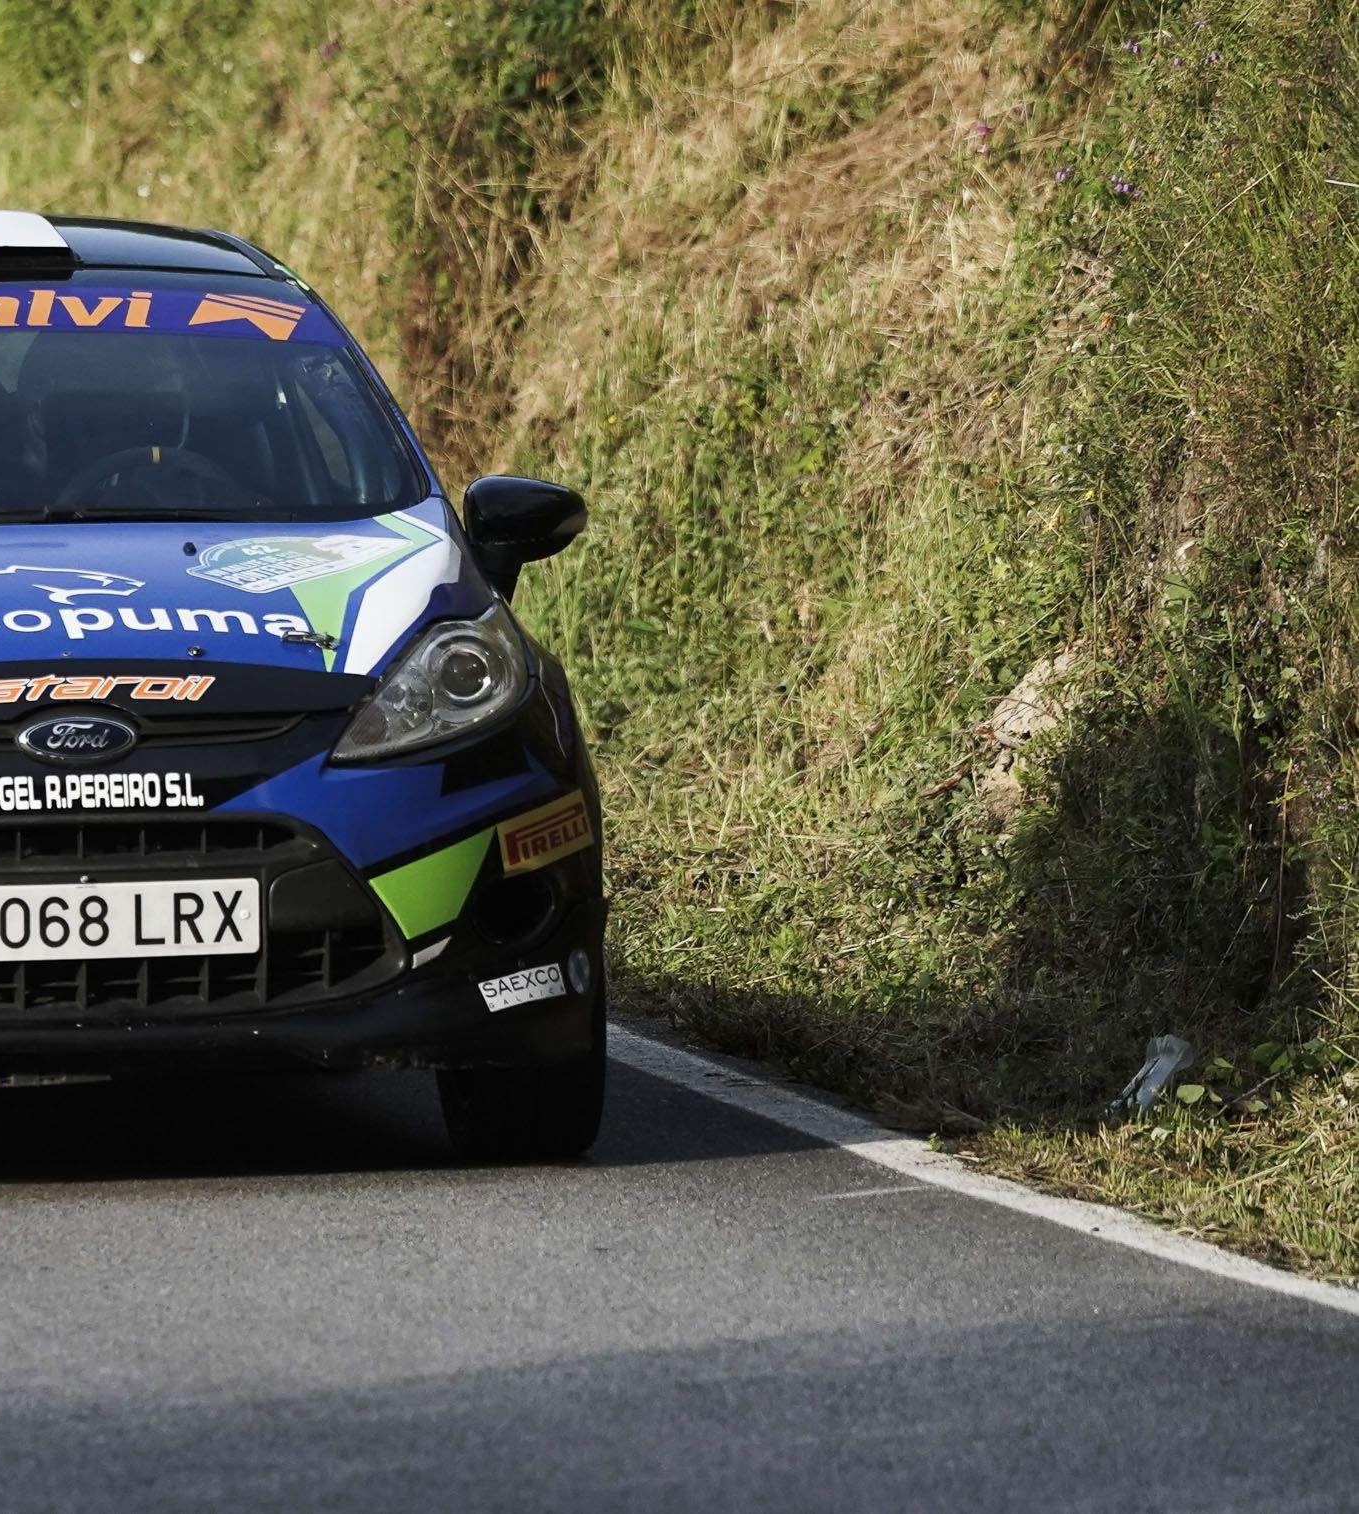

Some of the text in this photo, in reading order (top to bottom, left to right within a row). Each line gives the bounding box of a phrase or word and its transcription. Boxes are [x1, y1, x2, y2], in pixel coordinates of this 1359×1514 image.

[47, 722, 109, 749] Ford
[45, 772, 161, 809] R.PEREIRO
[165, 772, 204, 808] S.L.
[504, 801, 590, 866] PIRELLI
[134, 890, 243, 947] LRX
[482, 966, 560, 998] SAEXCO
